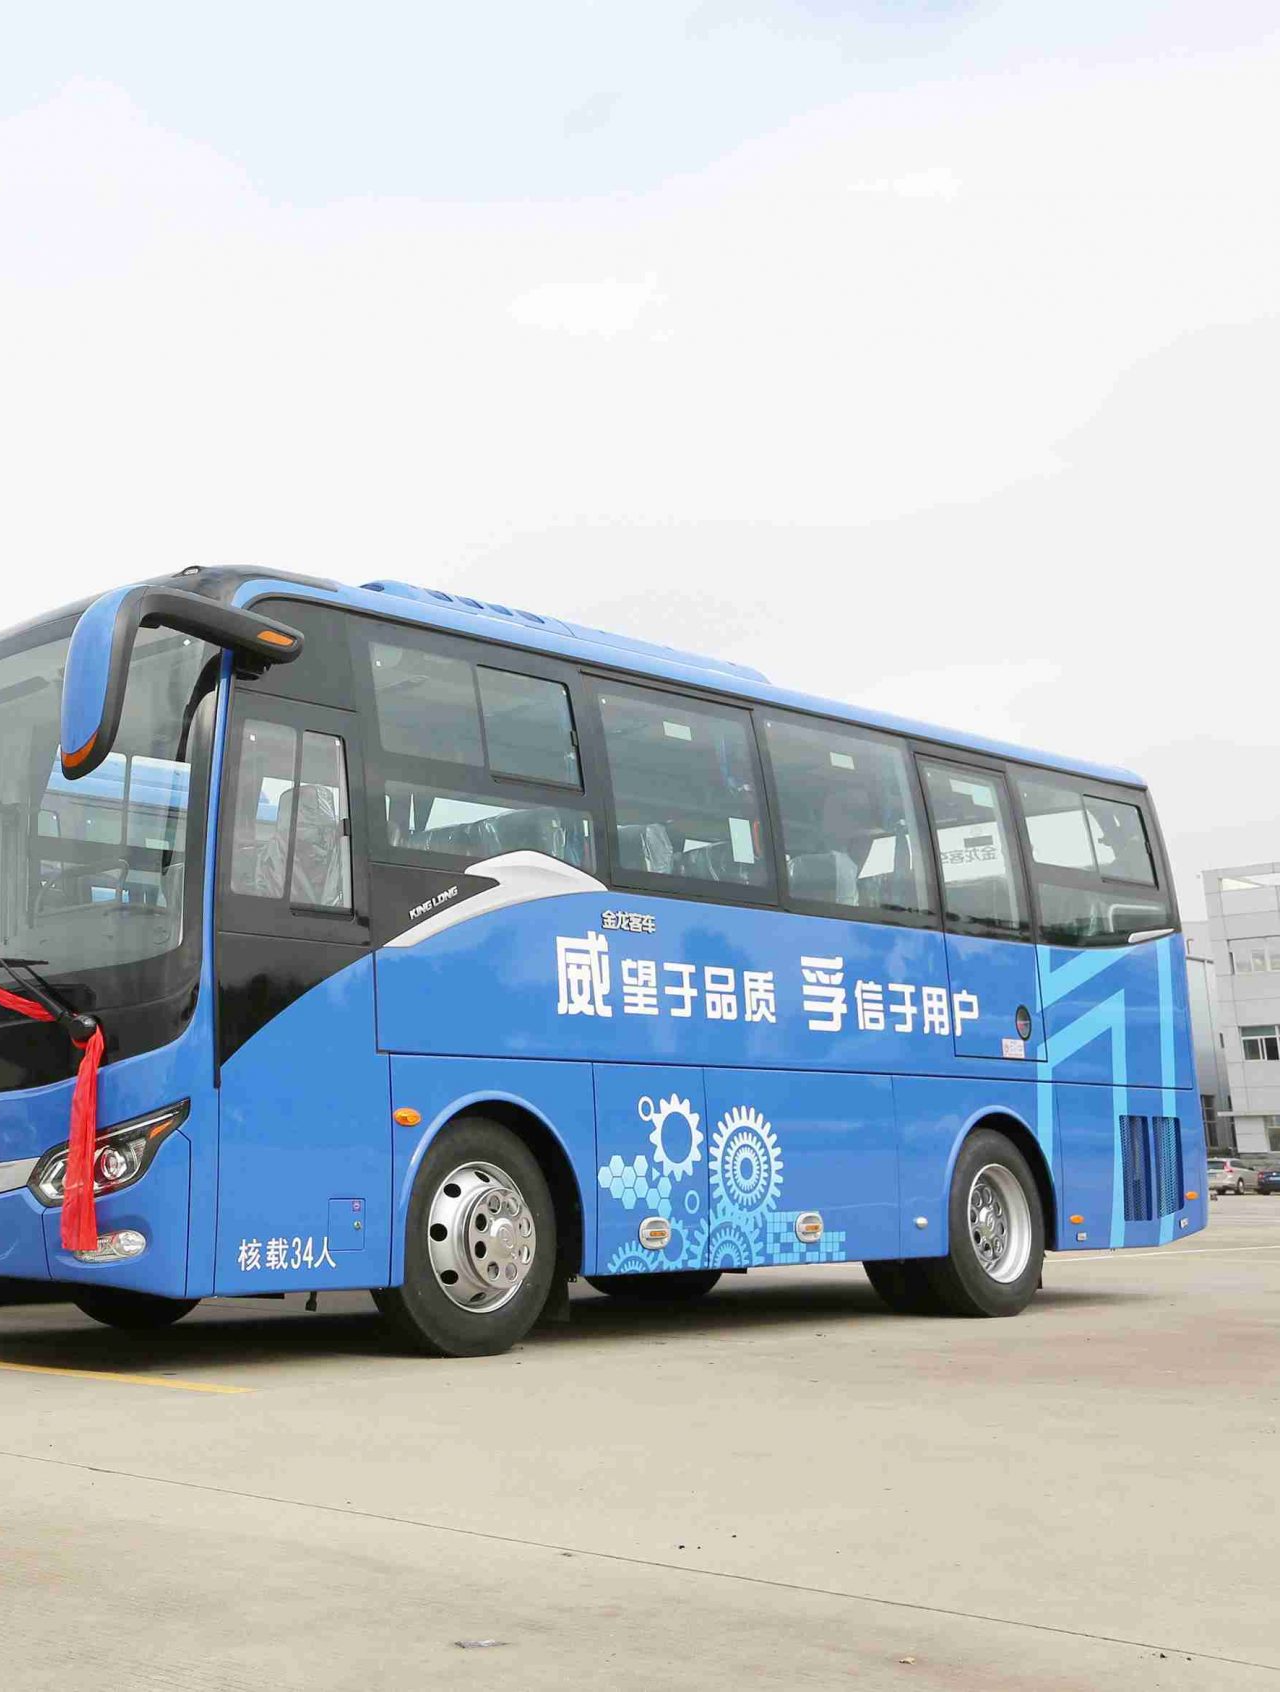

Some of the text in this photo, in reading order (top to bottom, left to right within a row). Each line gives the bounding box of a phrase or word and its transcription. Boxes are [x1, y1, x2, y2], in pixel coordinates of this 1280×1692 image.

[409, 885, 458, 920] KING LONG
[602, 910, 656, 933] 金龙客车
[555, 930, 980, 1037] 威望于品质 孚信于用户
[238, 1236, 336, 1272] 核载34人
